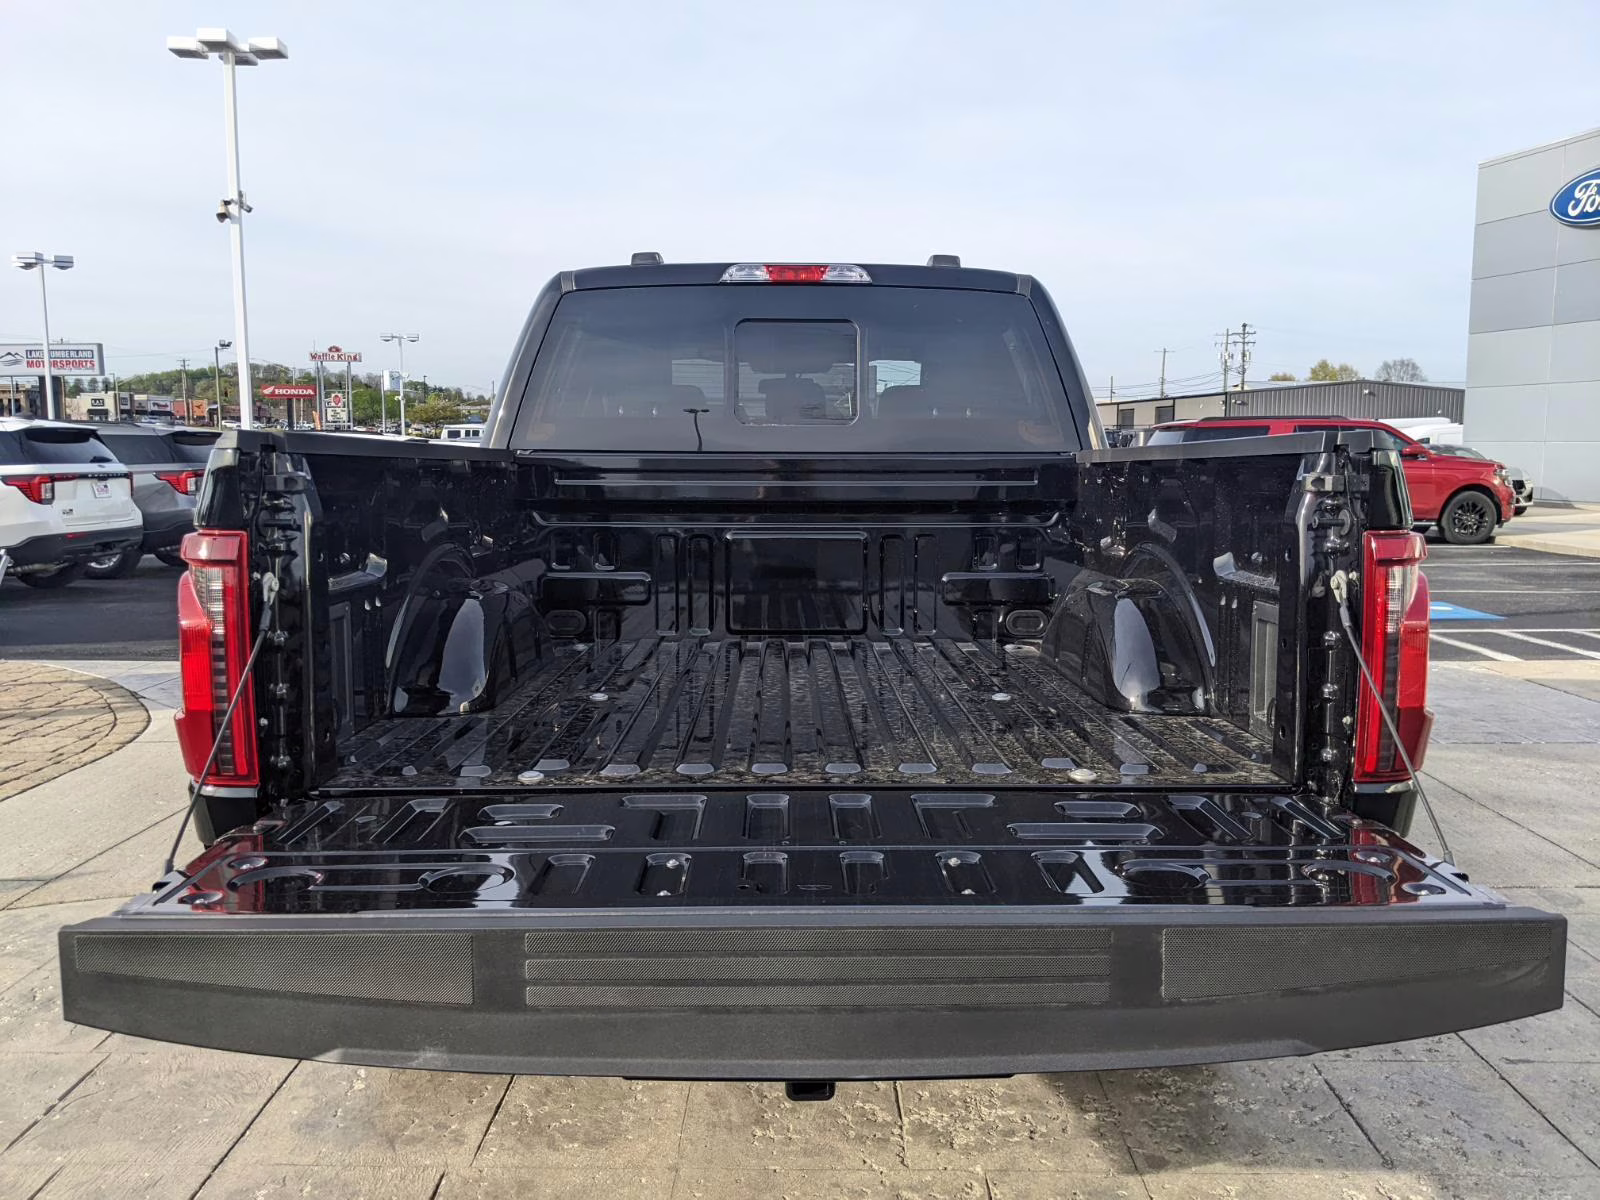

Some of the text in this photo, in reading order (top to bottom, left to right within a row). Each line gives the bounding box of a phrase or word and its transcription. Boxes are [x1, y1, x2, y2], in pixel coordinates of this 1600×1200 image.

[50, 350, 93, 358] UMBERLAND
[310, 352, 358, 361] Waffle King
[27, 360, 95, 368] MOTRSPORTS
